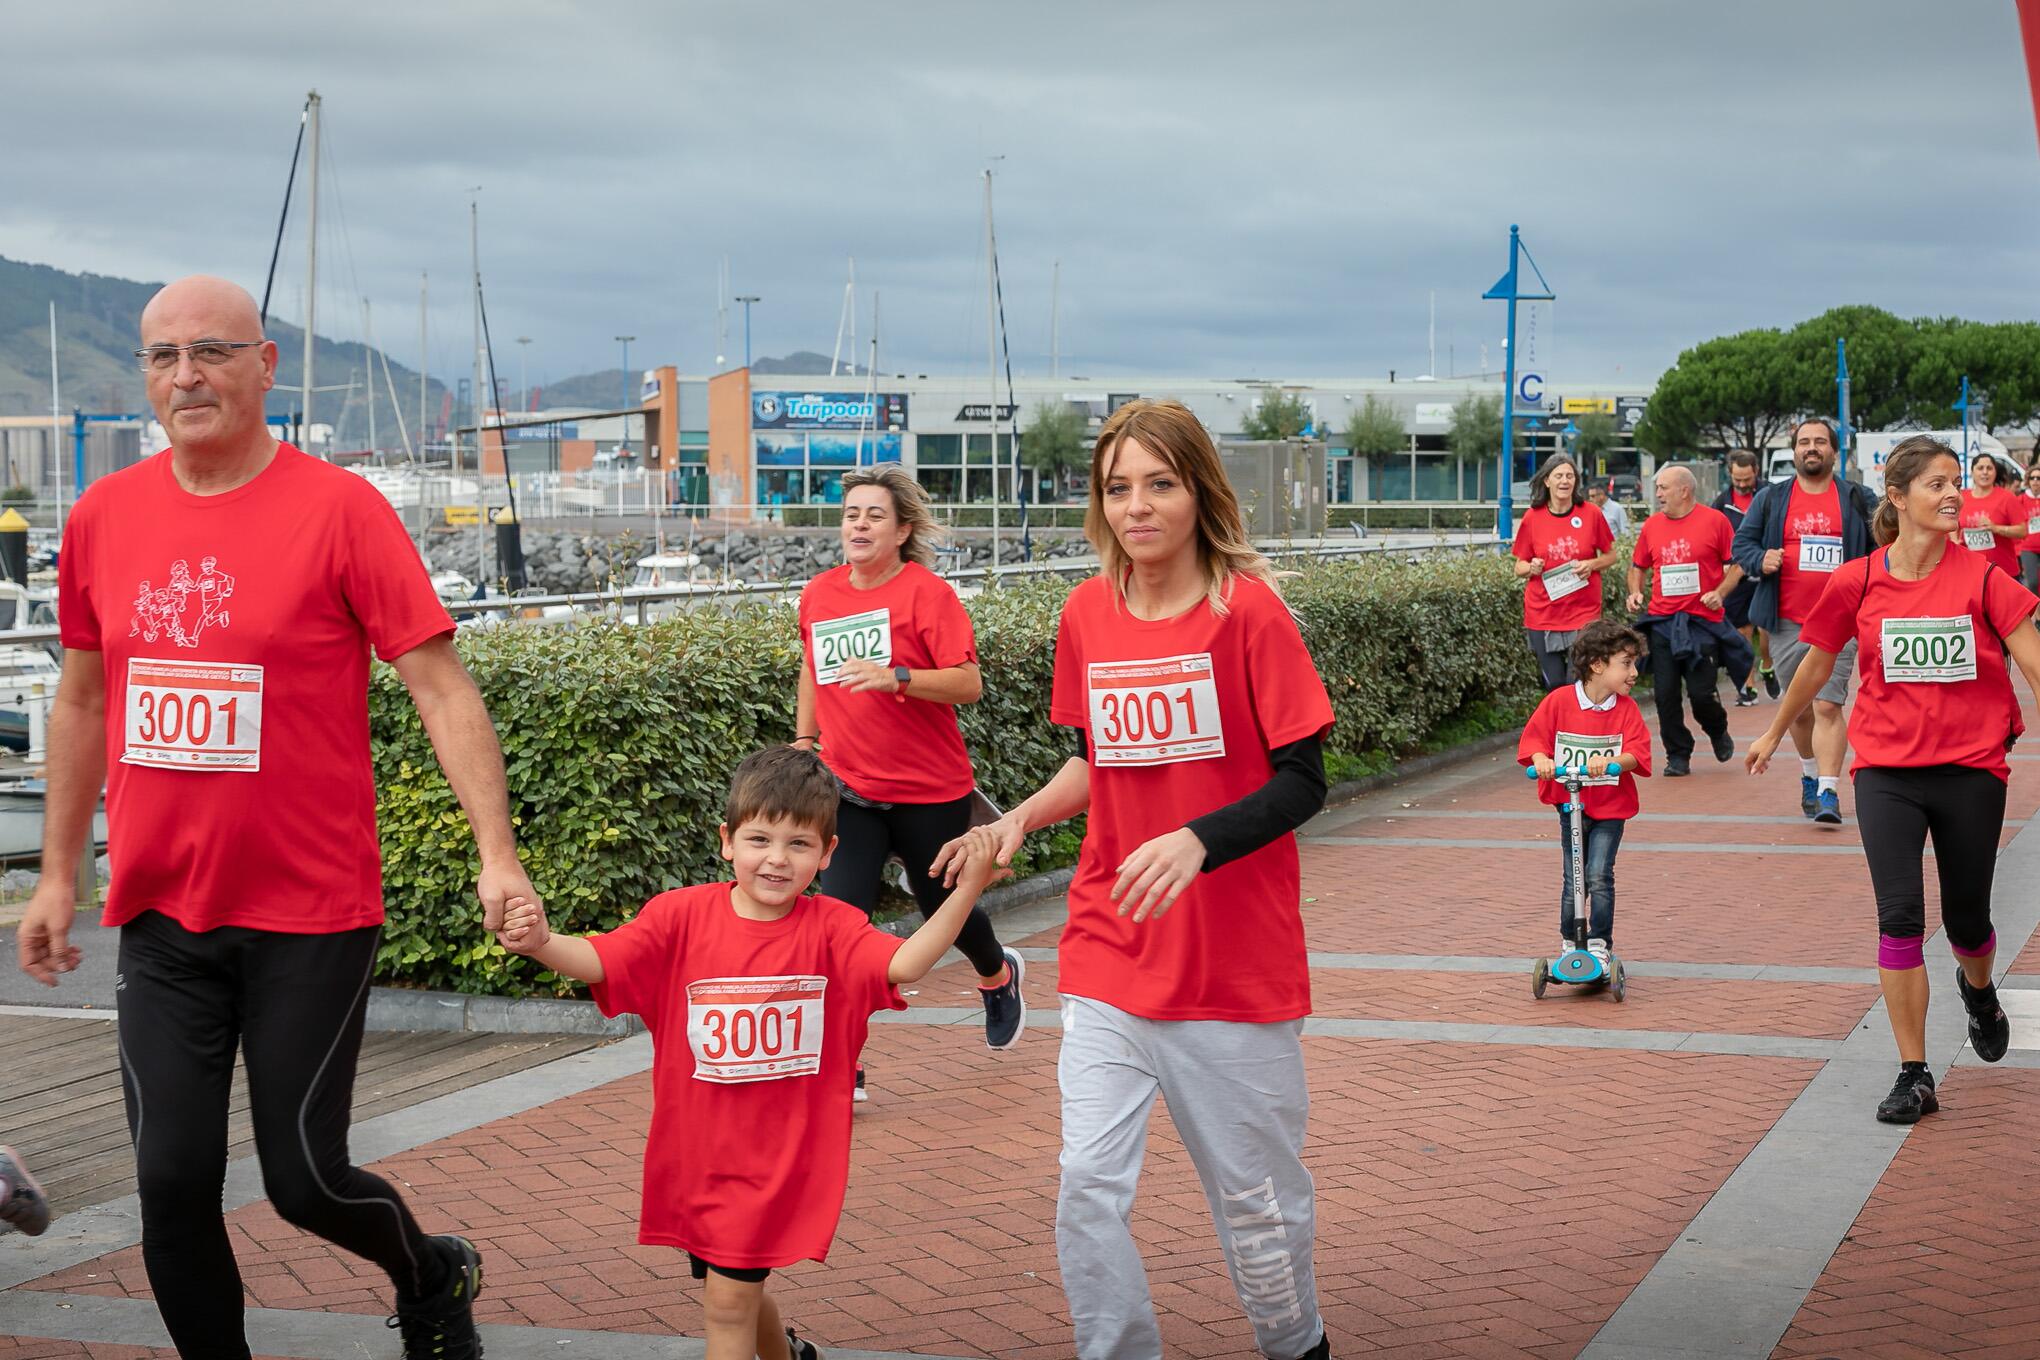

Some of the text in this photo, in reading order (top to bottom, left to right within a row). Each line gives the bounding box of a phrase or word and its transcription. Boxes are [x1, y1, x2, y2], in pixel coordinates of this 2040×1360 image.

[1520, 374, 1543, 402] C
[787, 399, 874, 421] Tarpoon
[1807, 546, 1842, 563] 1011
[1967, 532, 1991, 545] 2053
[822, 628, 883, 666] 2002
[1893, 634, 1966, 666] 2002
[138, 691, 237, 745] 3001
[1102, 688, 1197, 742] 3001
[1571, 827, 1582, 895] GLOBBER
[703, 1005, 802, 1059] 3001
